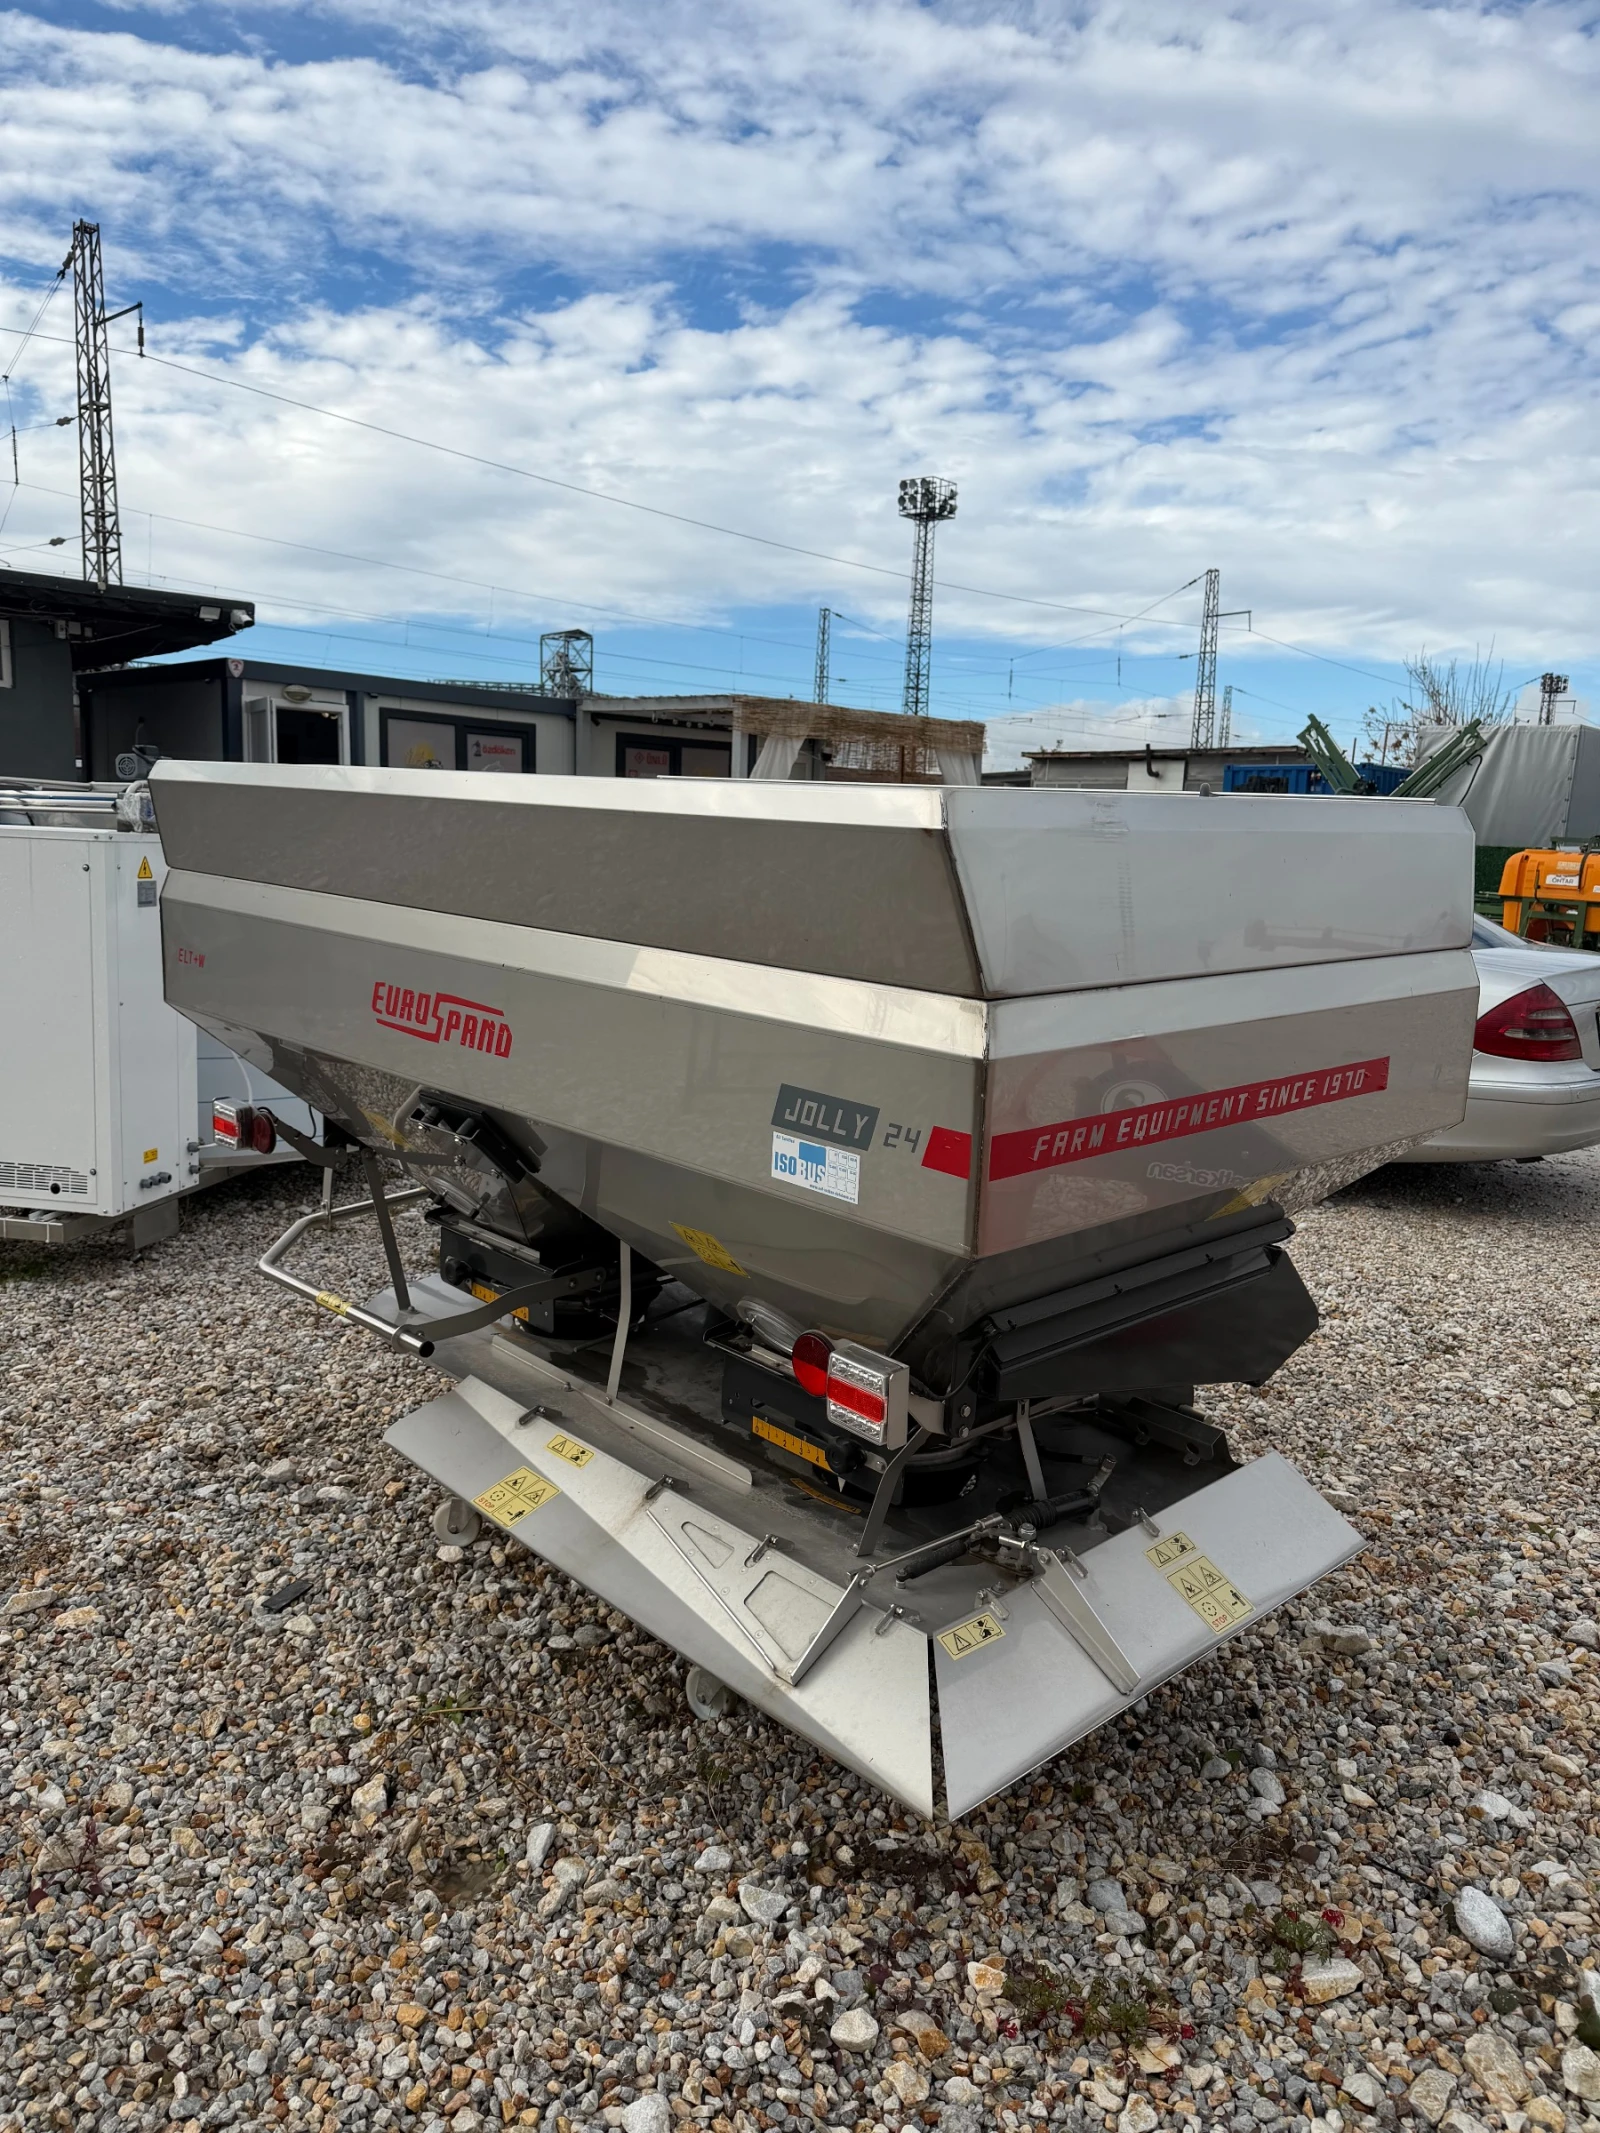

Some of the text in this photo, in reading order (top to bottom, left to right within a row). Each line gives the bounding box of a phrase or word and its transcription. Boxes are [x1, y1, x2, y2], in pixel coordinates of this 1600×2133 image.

[372, 981, 513, 1059] EUROSPAND
[784, 1098, 922, 1154] JOLLY 24
[1032, 1069, 1366, 1161] FARM EQUIPMENT SINCE 1970
[478, 1496, 495, 1508] STOP
[1212, 1614, 1228, 1628] STOP
